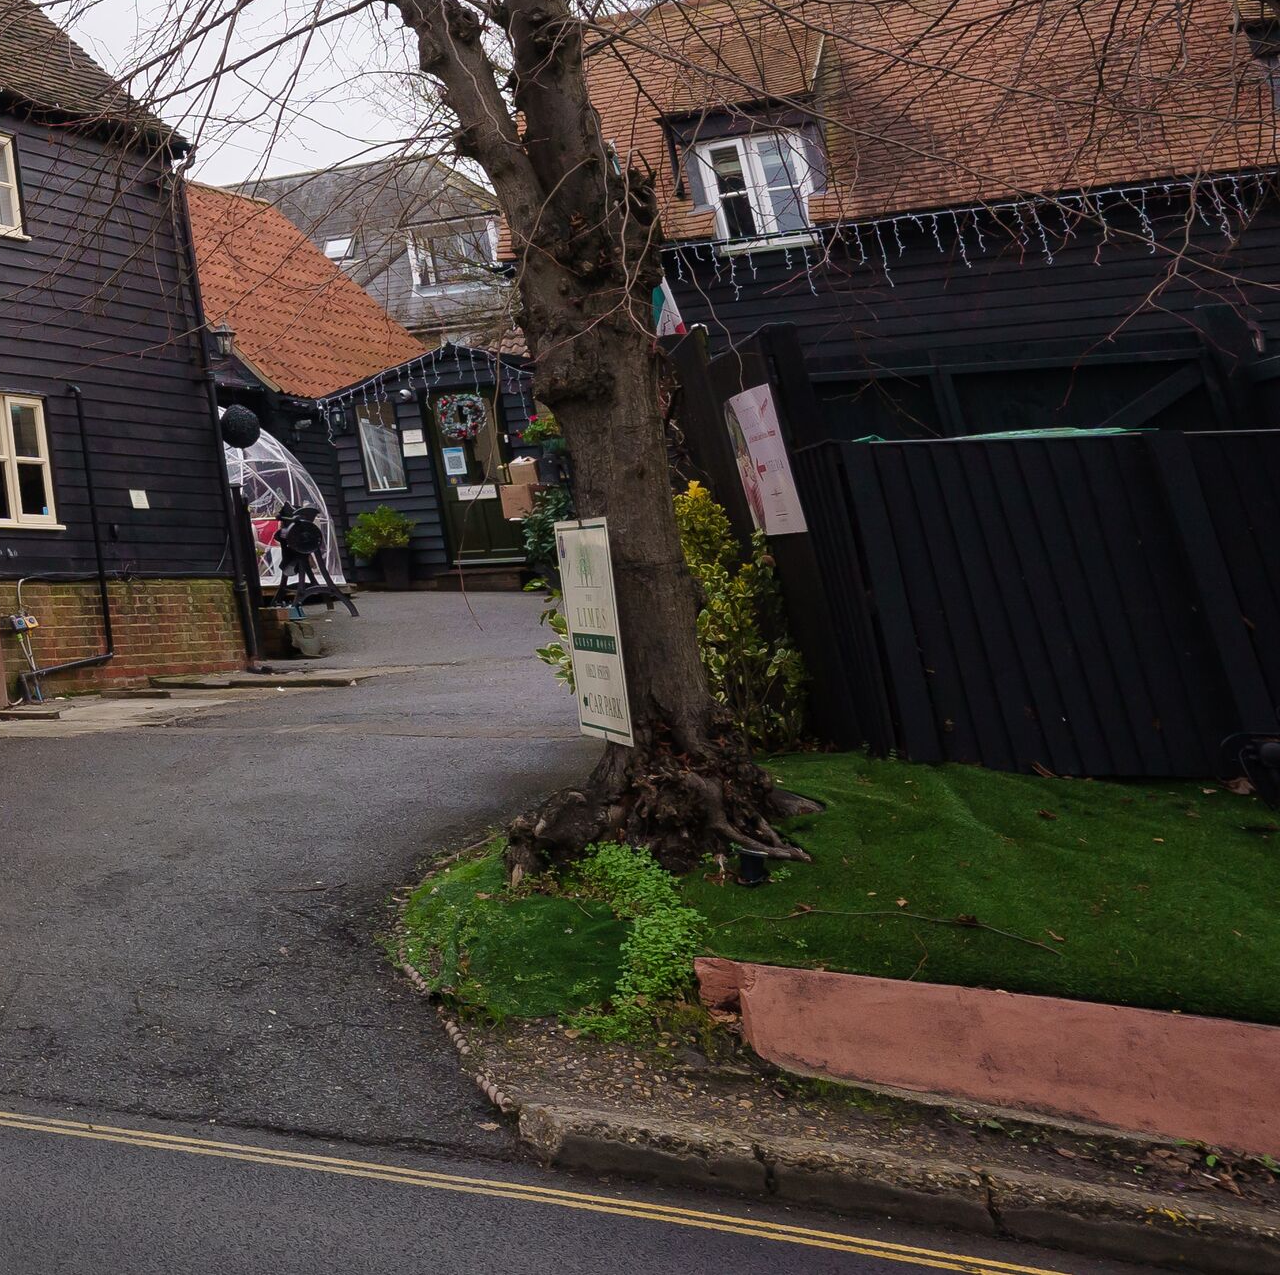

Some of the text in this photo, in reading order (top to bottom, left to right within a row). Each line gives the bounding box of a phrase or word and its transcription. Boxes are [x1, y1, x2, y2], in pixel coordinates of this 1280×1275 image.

[576, 607, 607, 630] LIMES
[588, 692, 624, 720] CAR PARK
